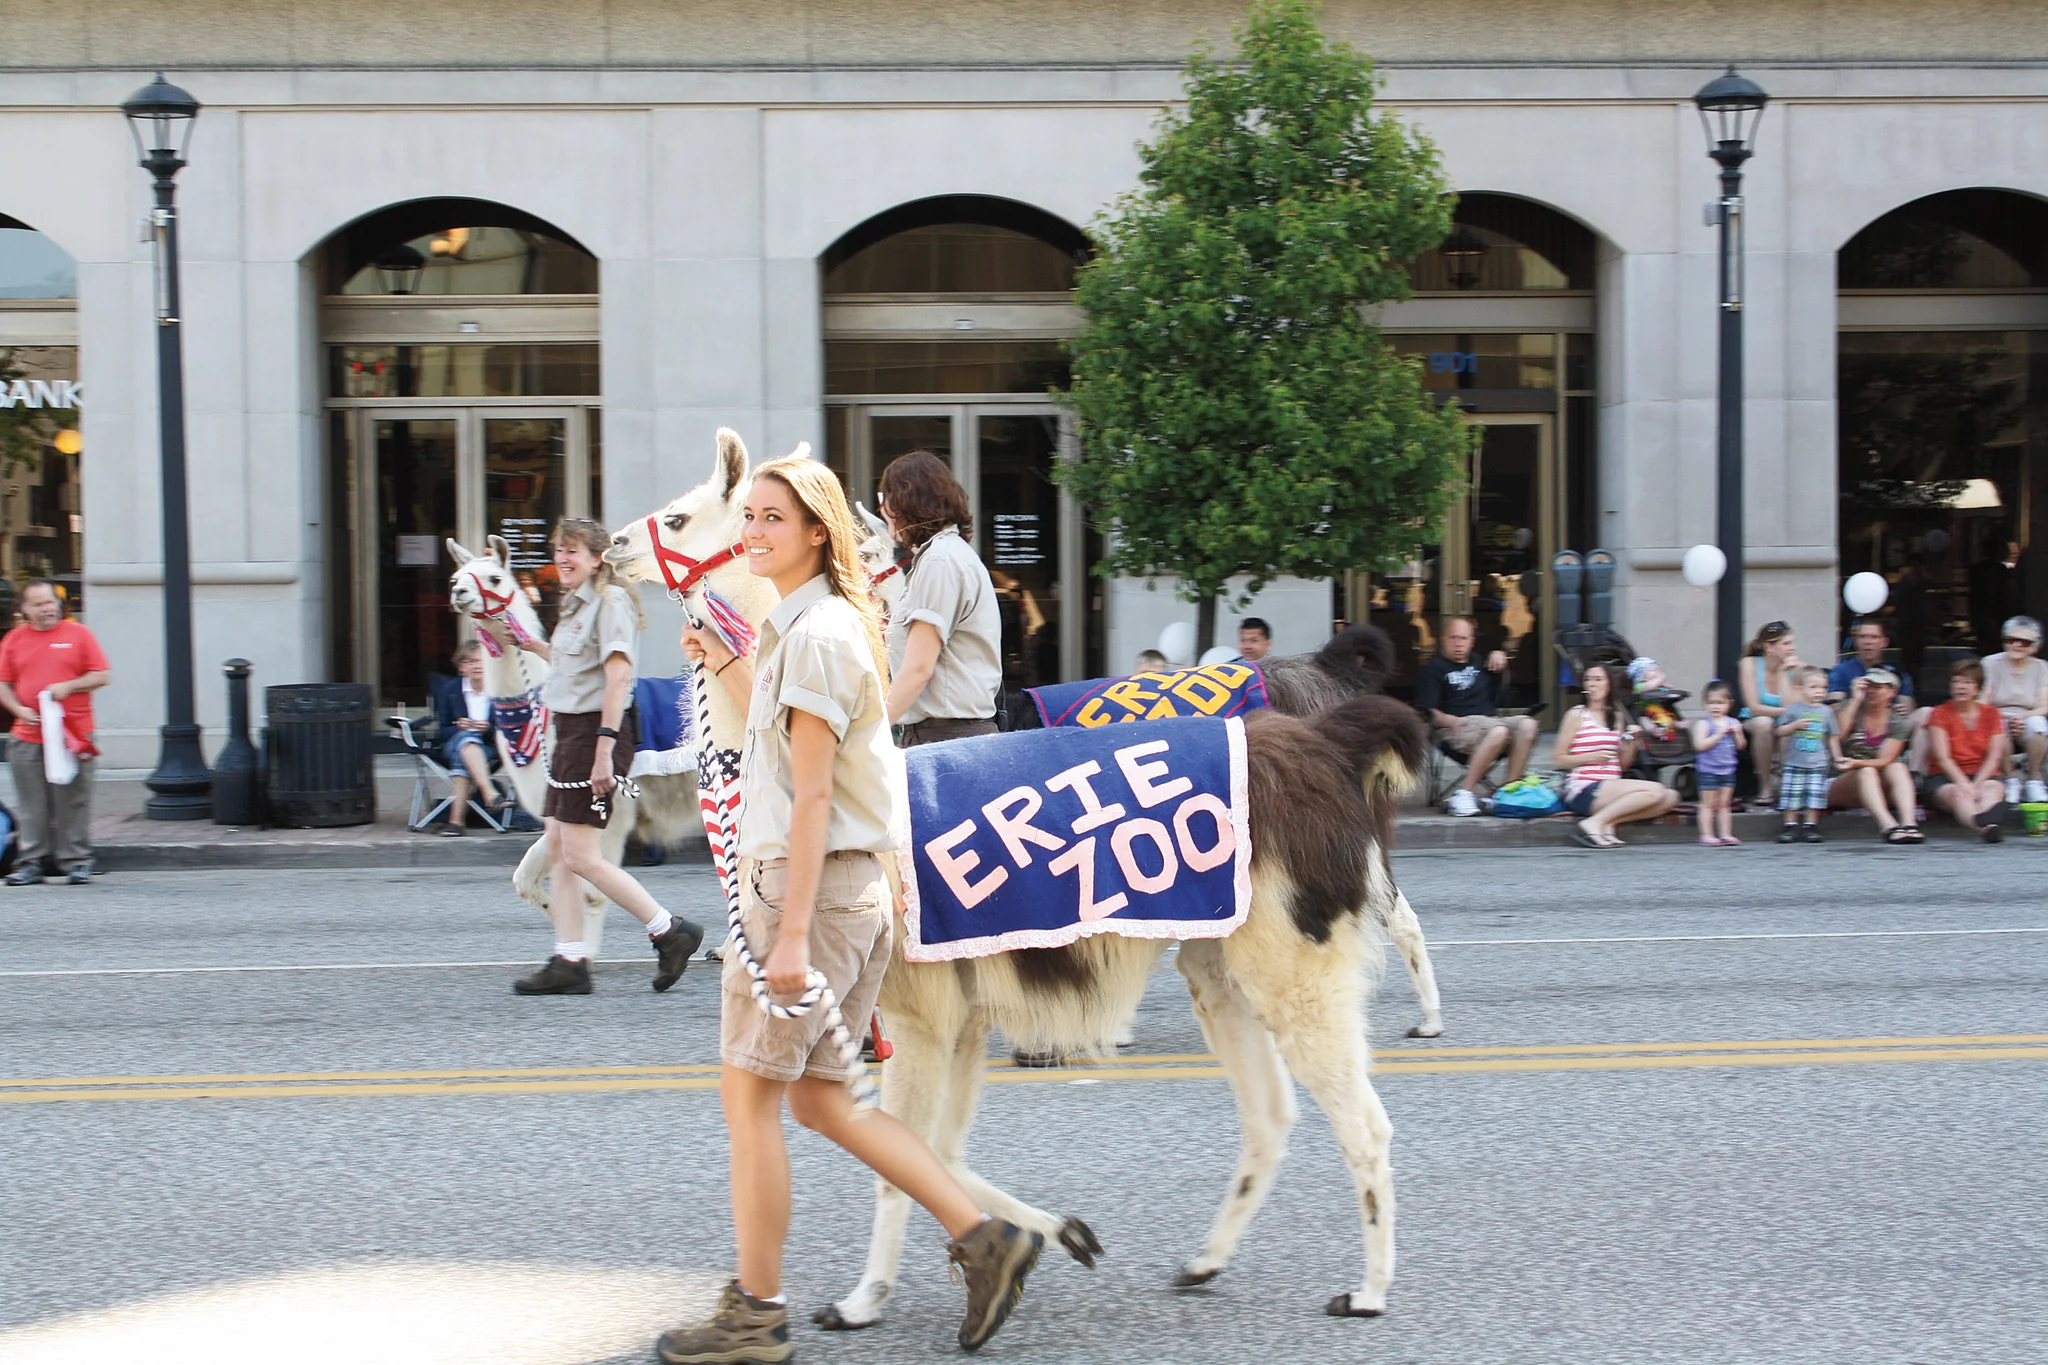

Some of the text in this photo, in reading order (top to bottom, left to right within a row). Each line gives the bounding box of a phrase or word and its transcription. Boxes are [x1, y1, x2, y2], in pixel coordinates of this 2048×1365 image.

[1428, 351, 1478, 373] 901
[1076, 663, 1211, 728] ERI
[924, 739, 1193, 909] ERIE
[1048, 793, 1238, 922] ZOO
